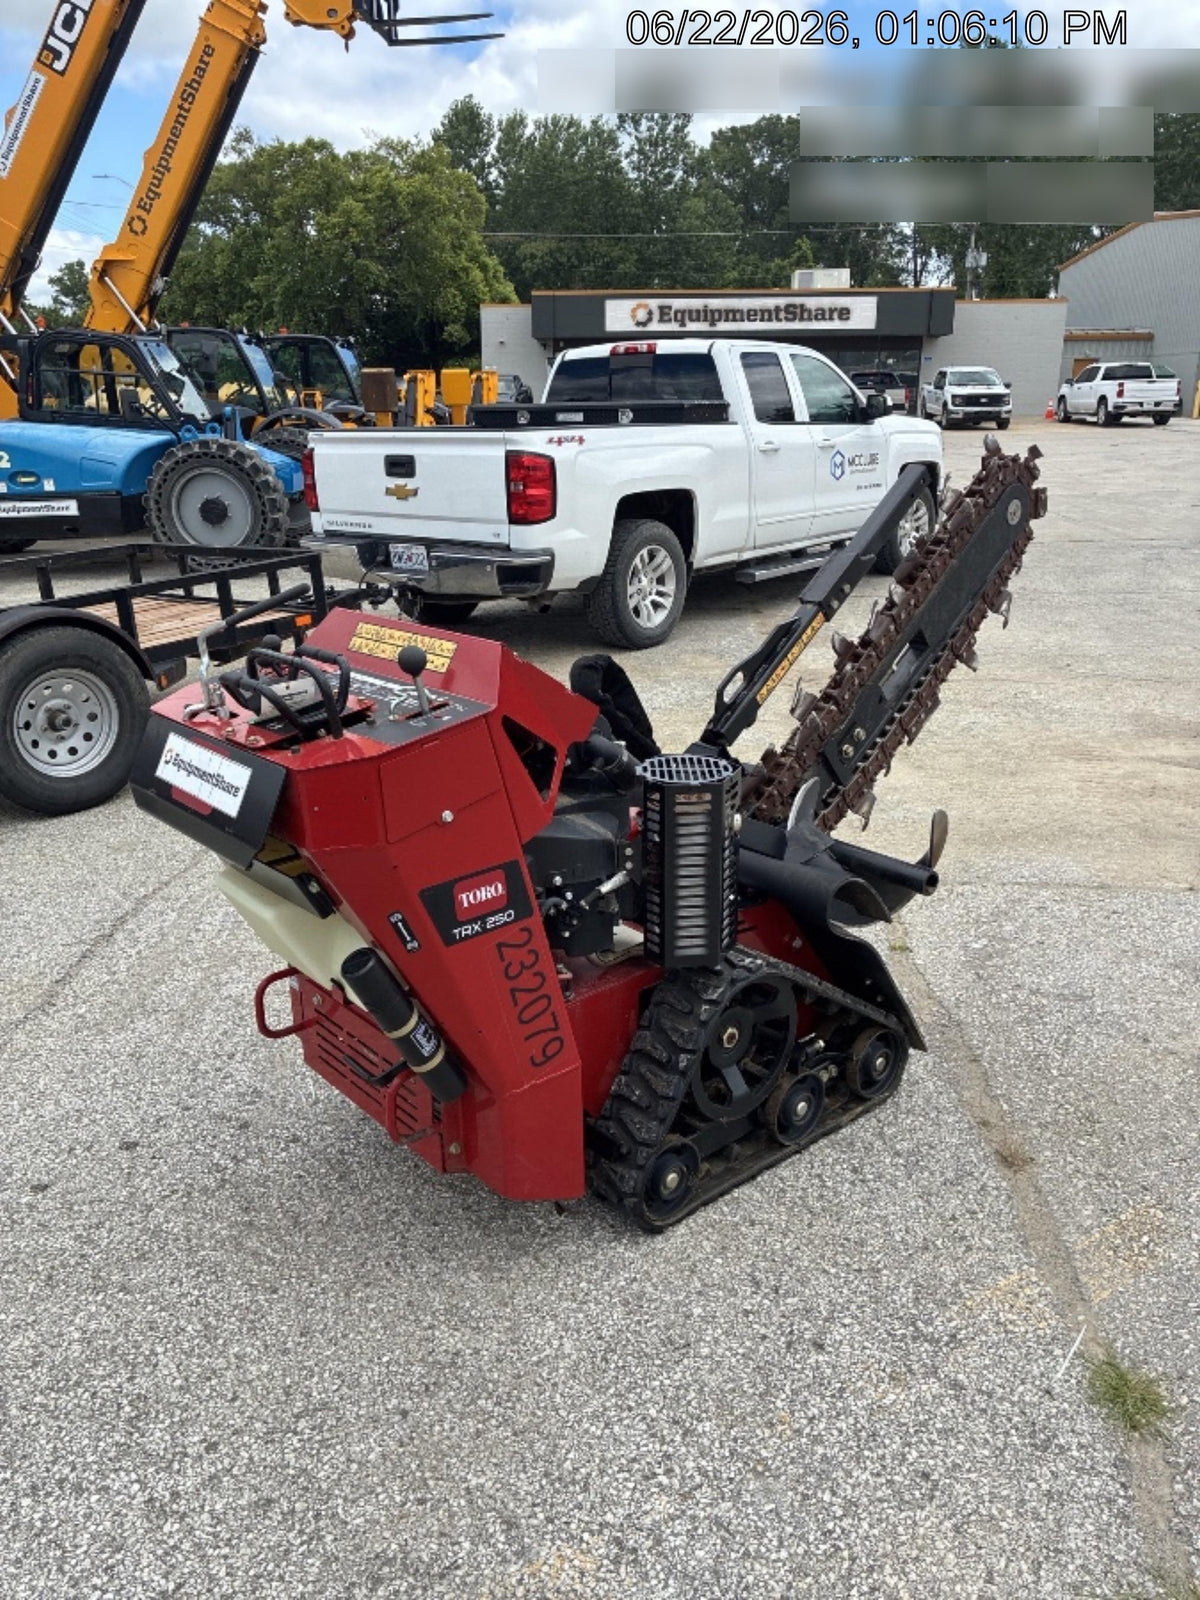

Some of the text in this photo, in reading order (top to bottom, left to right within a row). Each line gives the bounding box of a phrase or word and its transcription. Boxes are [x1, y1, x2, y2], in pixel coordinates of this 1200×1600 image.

[137, 43, 216, 216] EquipmentShare
[657, 303, 851, 328] EquipmentShare
[172, 752, 241, 798] EquipmentShare
[458, 881, 503, 908] TORO
[496, 926, 565, 1068] 232079
